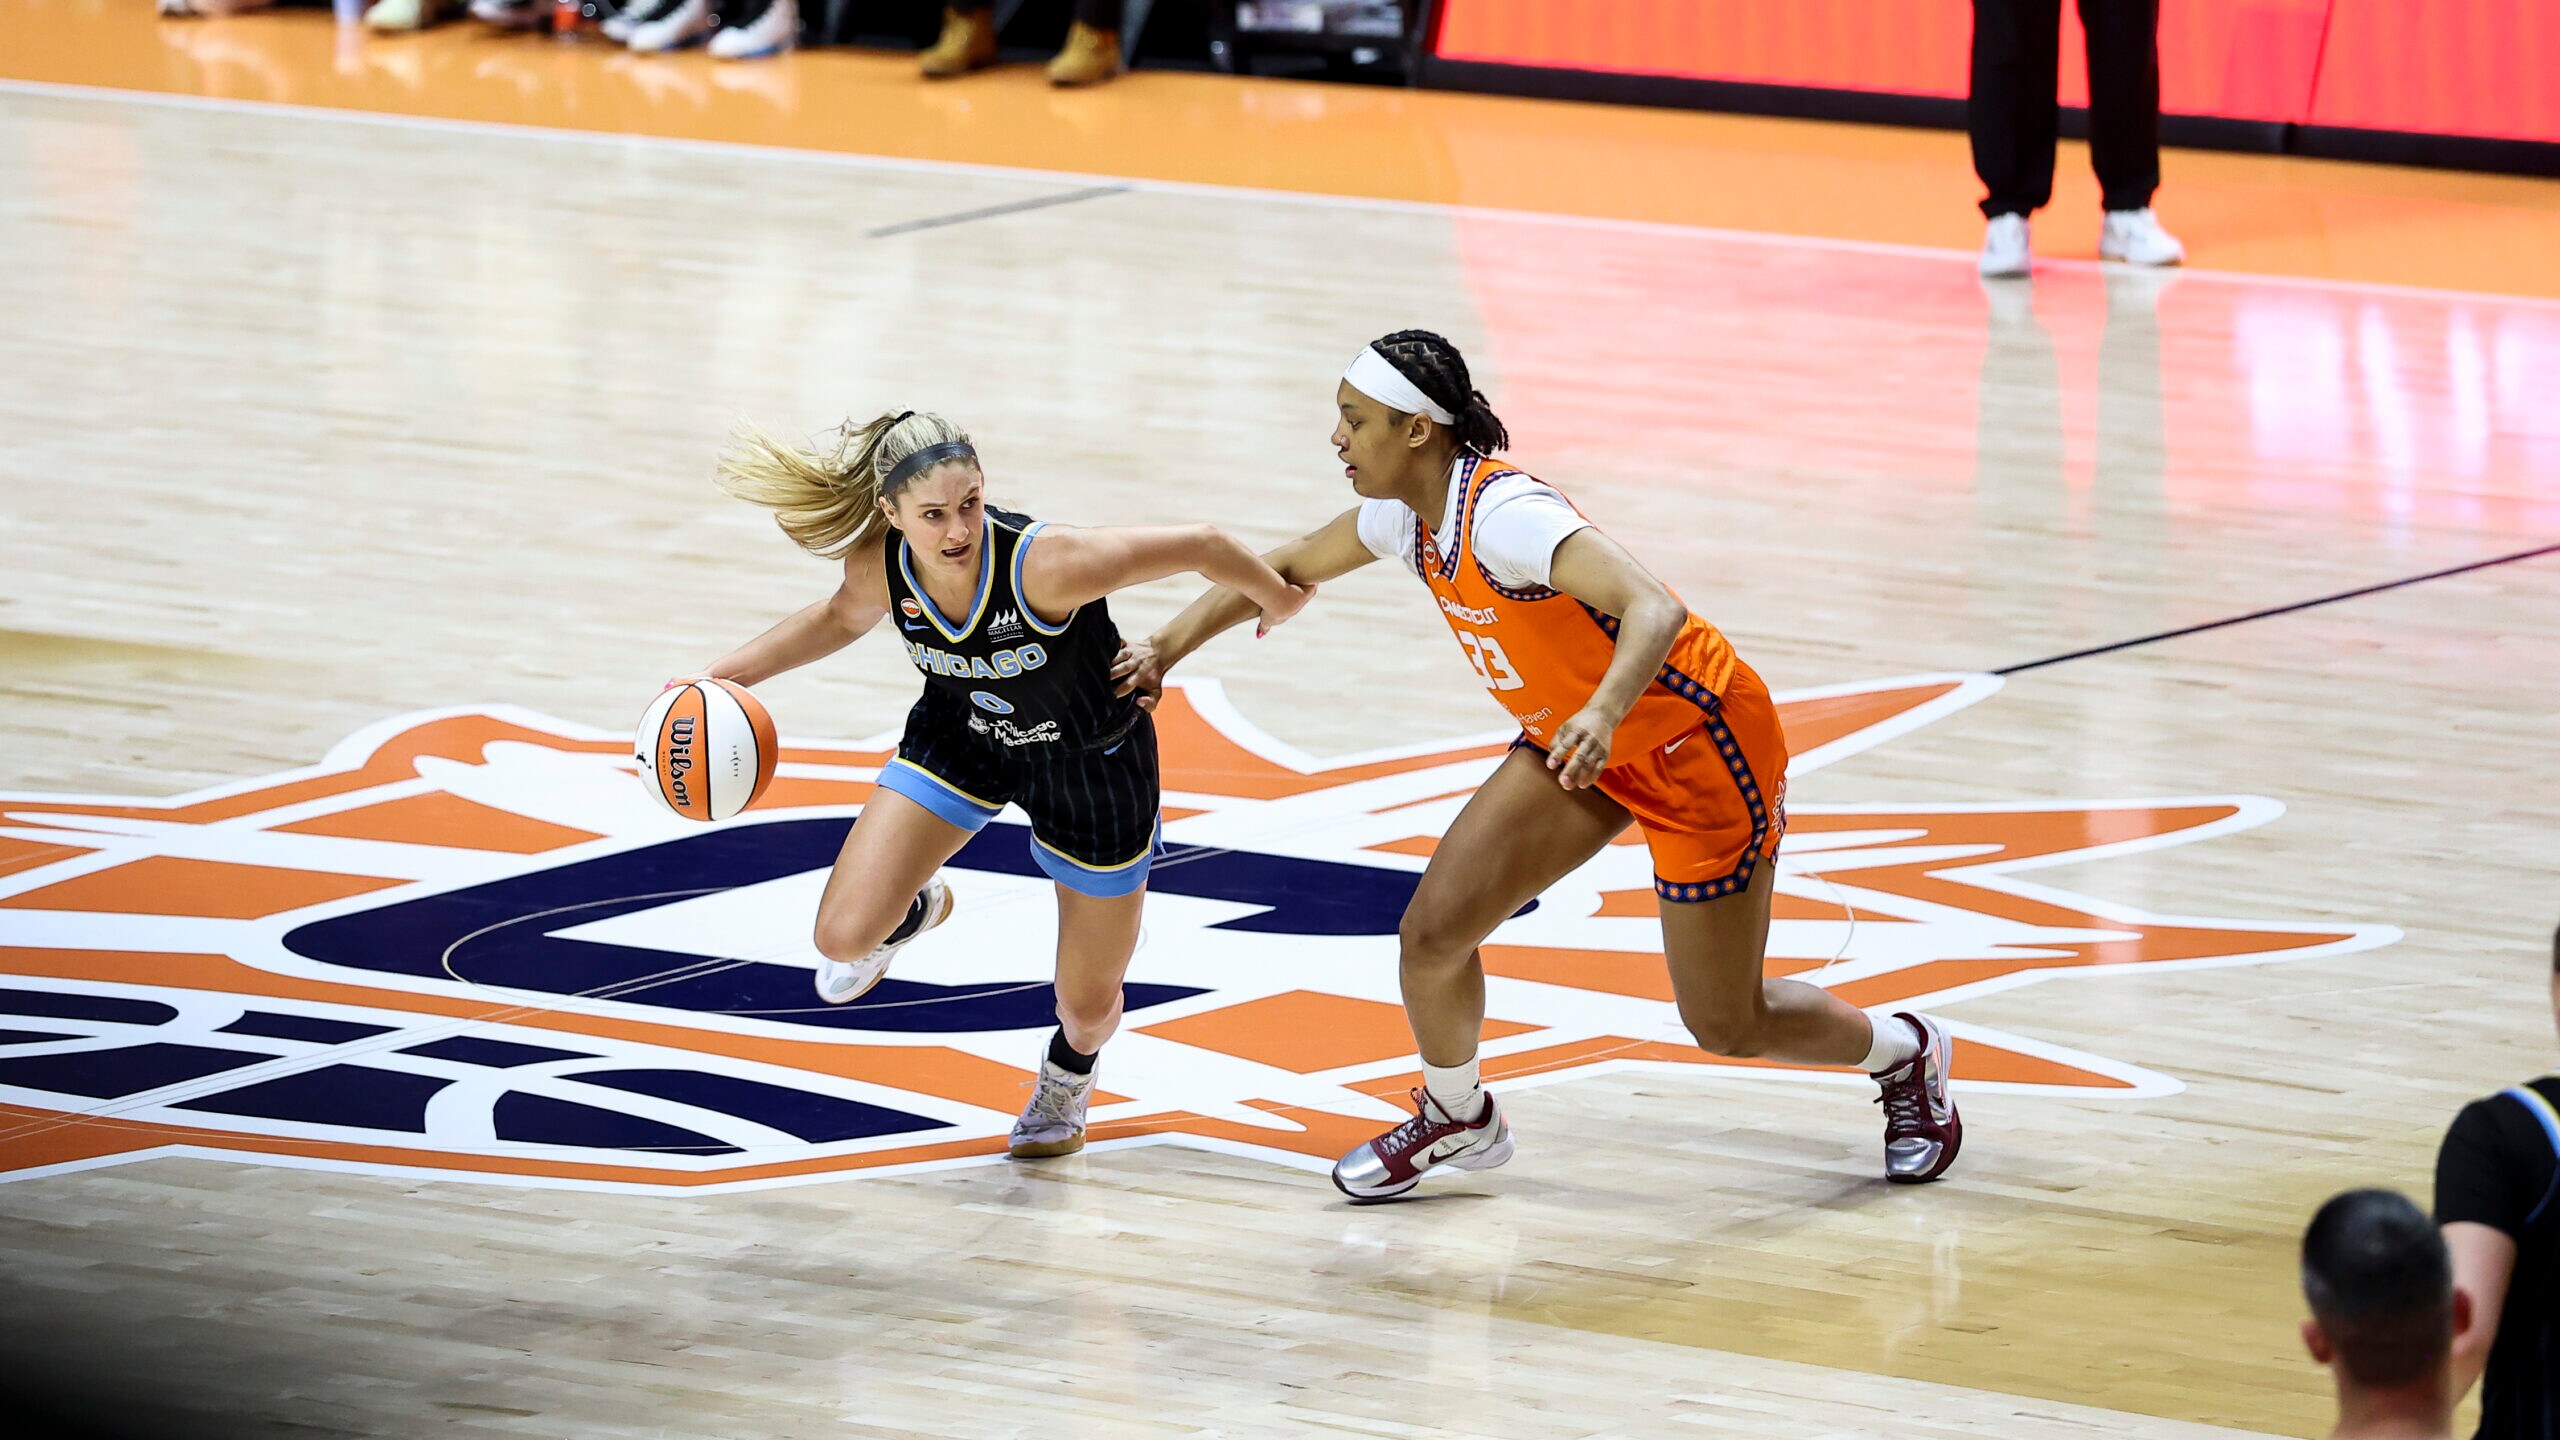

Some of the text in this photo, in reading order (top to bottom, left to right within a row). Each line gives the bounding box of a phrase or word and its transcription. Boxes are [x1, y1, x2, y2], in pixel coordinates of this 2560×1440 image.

[903, 640, 1047, 679] CHICAGO
[1458, 629, 1525, 690] 33
[970, 691, 1014, 714] 0
[995, 727, 1061, 746] Medicine
[670, 716, 695, 807] Wilson
